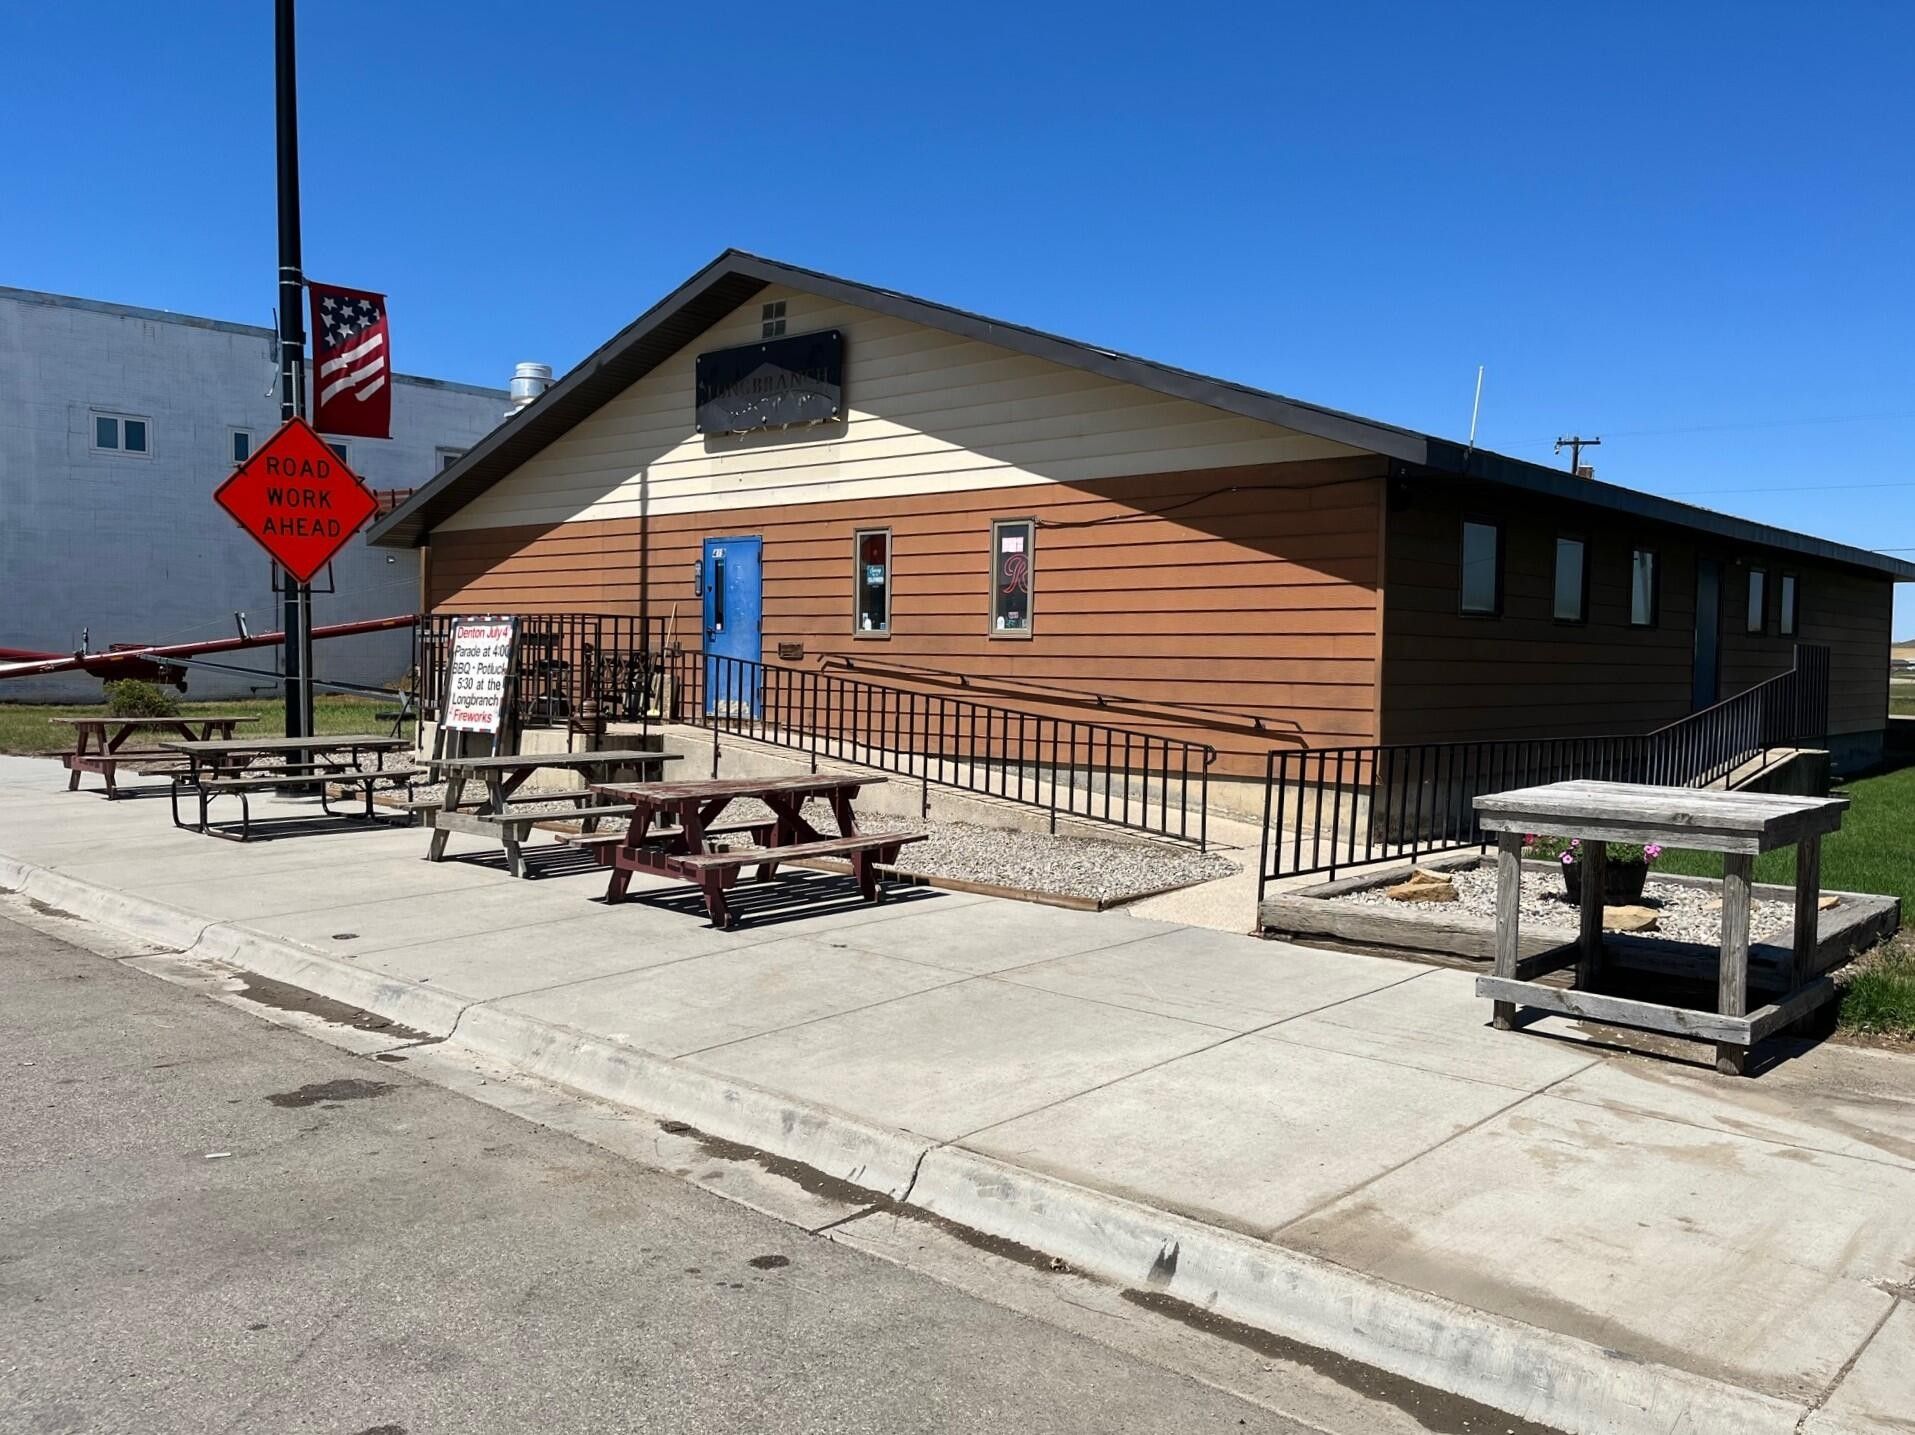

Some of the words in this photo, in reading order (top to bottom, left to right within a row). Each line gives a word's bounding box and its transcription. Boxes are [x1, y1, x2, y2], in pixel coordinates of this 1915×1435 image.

[266, 457, 330, 479] ROAD
[267, 487, 332, 509] WORK
[262, 517, 341, 538] AHEAD
[457, 627, 485, 639] Denton
[487, 626, 501, 641] July
[454, 645, 480, 657] Parade
[482, 646, 491, 657] at
[493, 645, 510, 658] 4:00
[452, 662, 471, 675] BBQ
[476, 662, 506, 675] Potluck
[457, 677, 473, 690] 5:30
[476, 678, 484, 690] at
[487, 678, 501, 691] the
[452, 693, 499, 708] Longbranch
[453, 709, 493, 723] Fireworks
